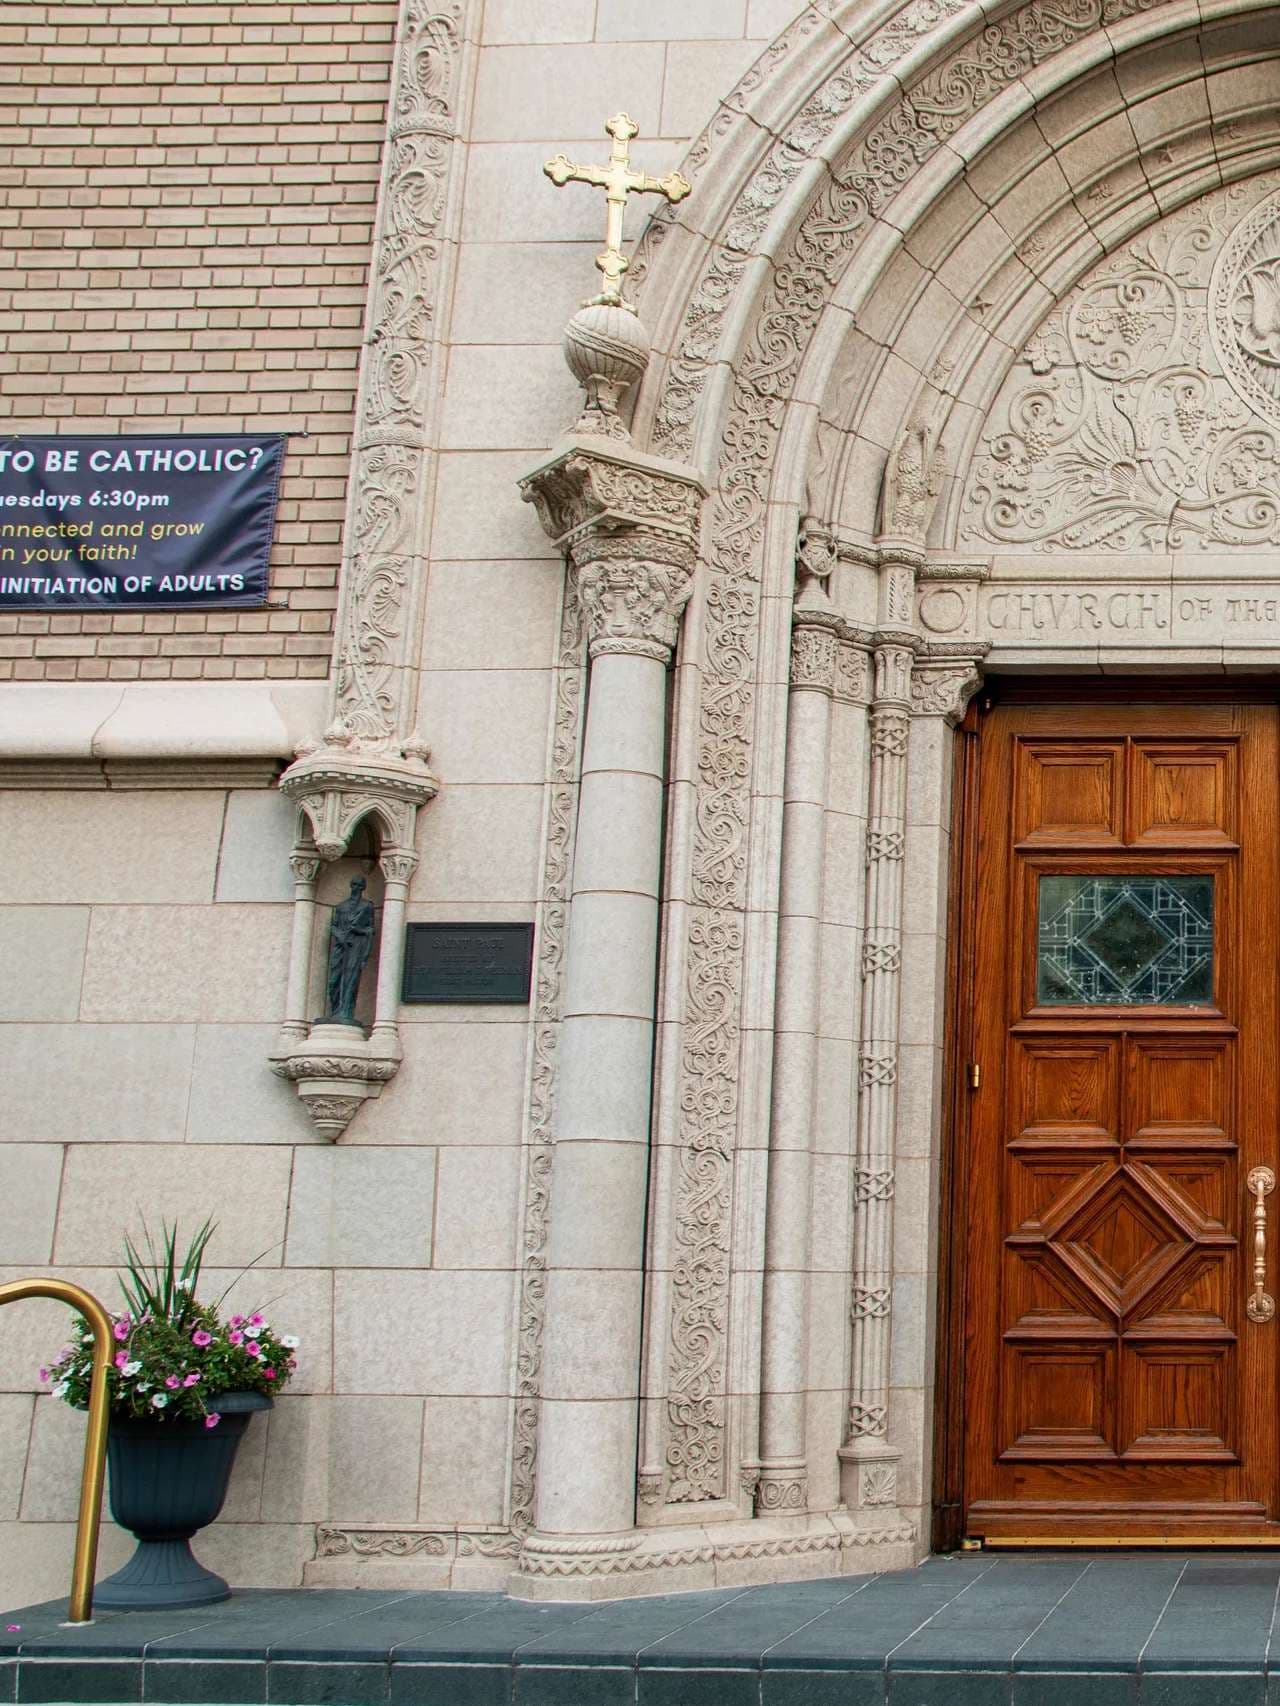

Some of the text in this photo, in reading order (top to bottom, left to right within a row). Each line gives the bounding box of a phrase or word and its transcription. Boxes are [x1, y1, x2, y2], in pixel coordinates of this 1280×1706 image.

[0, 447, 264, 472] TO BE CATHOLIC?
[88, 490, 170, 511] 6:30pm
[0, 520, 205, 541] nnected and grow
[21, 547, 73, 565] your
[78, 544, 137, 561] faith!
[0, 574, 245, 594] INITIATION OF ADULTS
[986, 592, 1167, 630] CHVRCH
[1178, 598, 1213, 622] OF
[1225, 598, 1278, 623] THE
